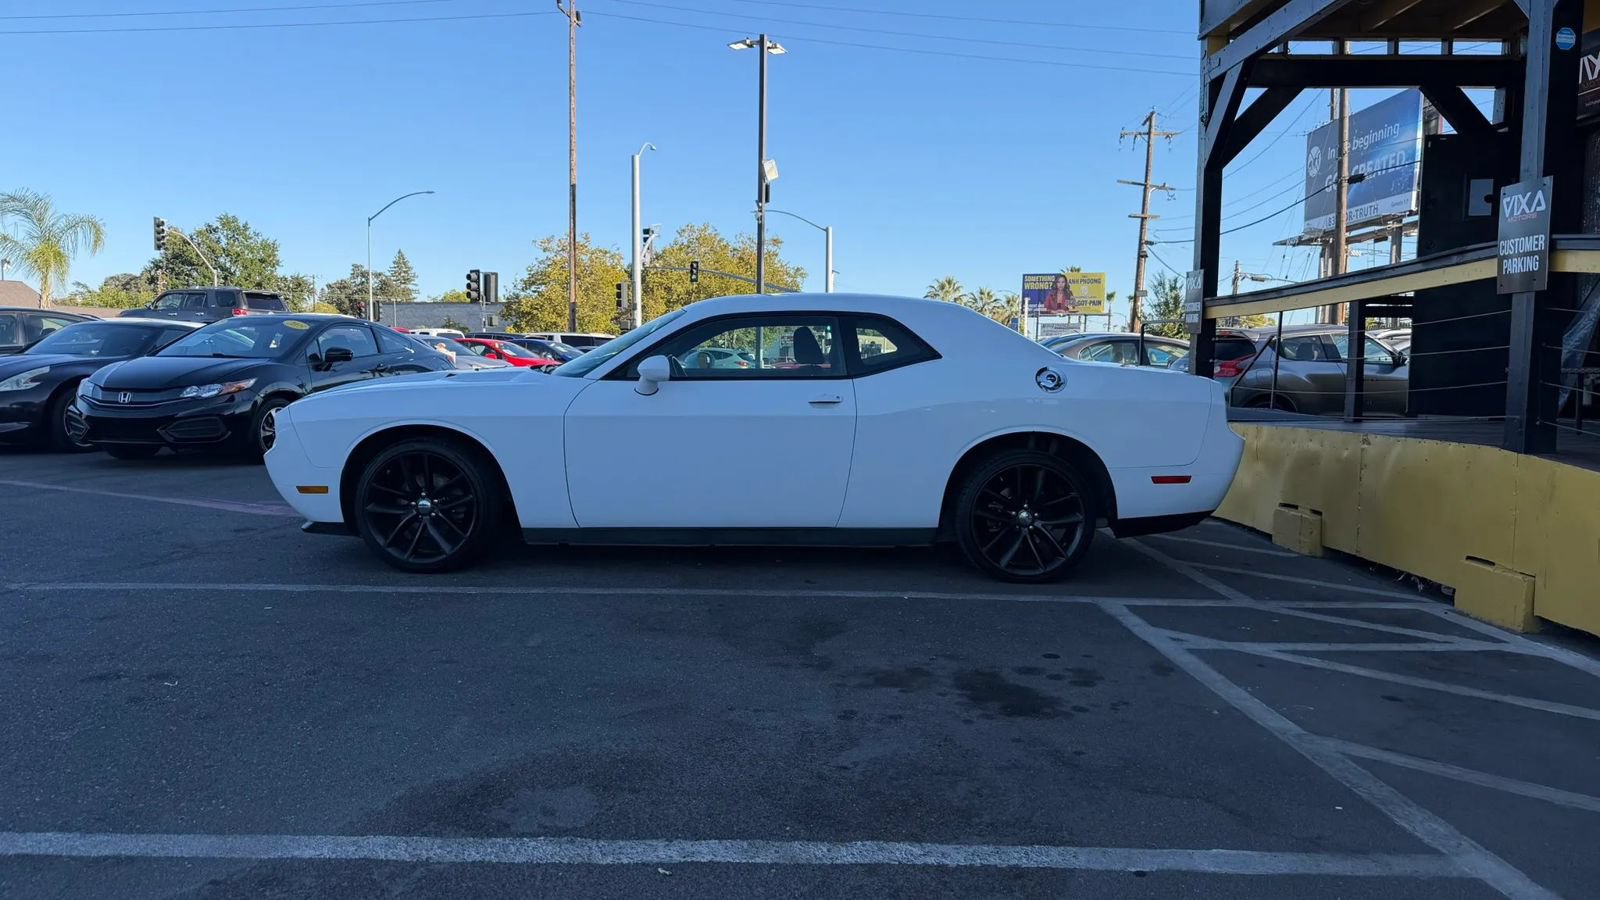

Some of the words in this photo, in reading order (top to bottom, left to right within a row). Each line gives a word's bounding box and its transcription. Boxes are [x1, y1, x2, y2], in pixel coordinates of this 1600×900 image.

[1352, 123, 1400, 151] beginning
[1502, 189, 1546, 218] VIXA
[1499, 234, 1546, 256] CUSTOMER
[1502, 255, 1540, 275] PARKING
[1024, 282, 1053, 290] WRONG?
